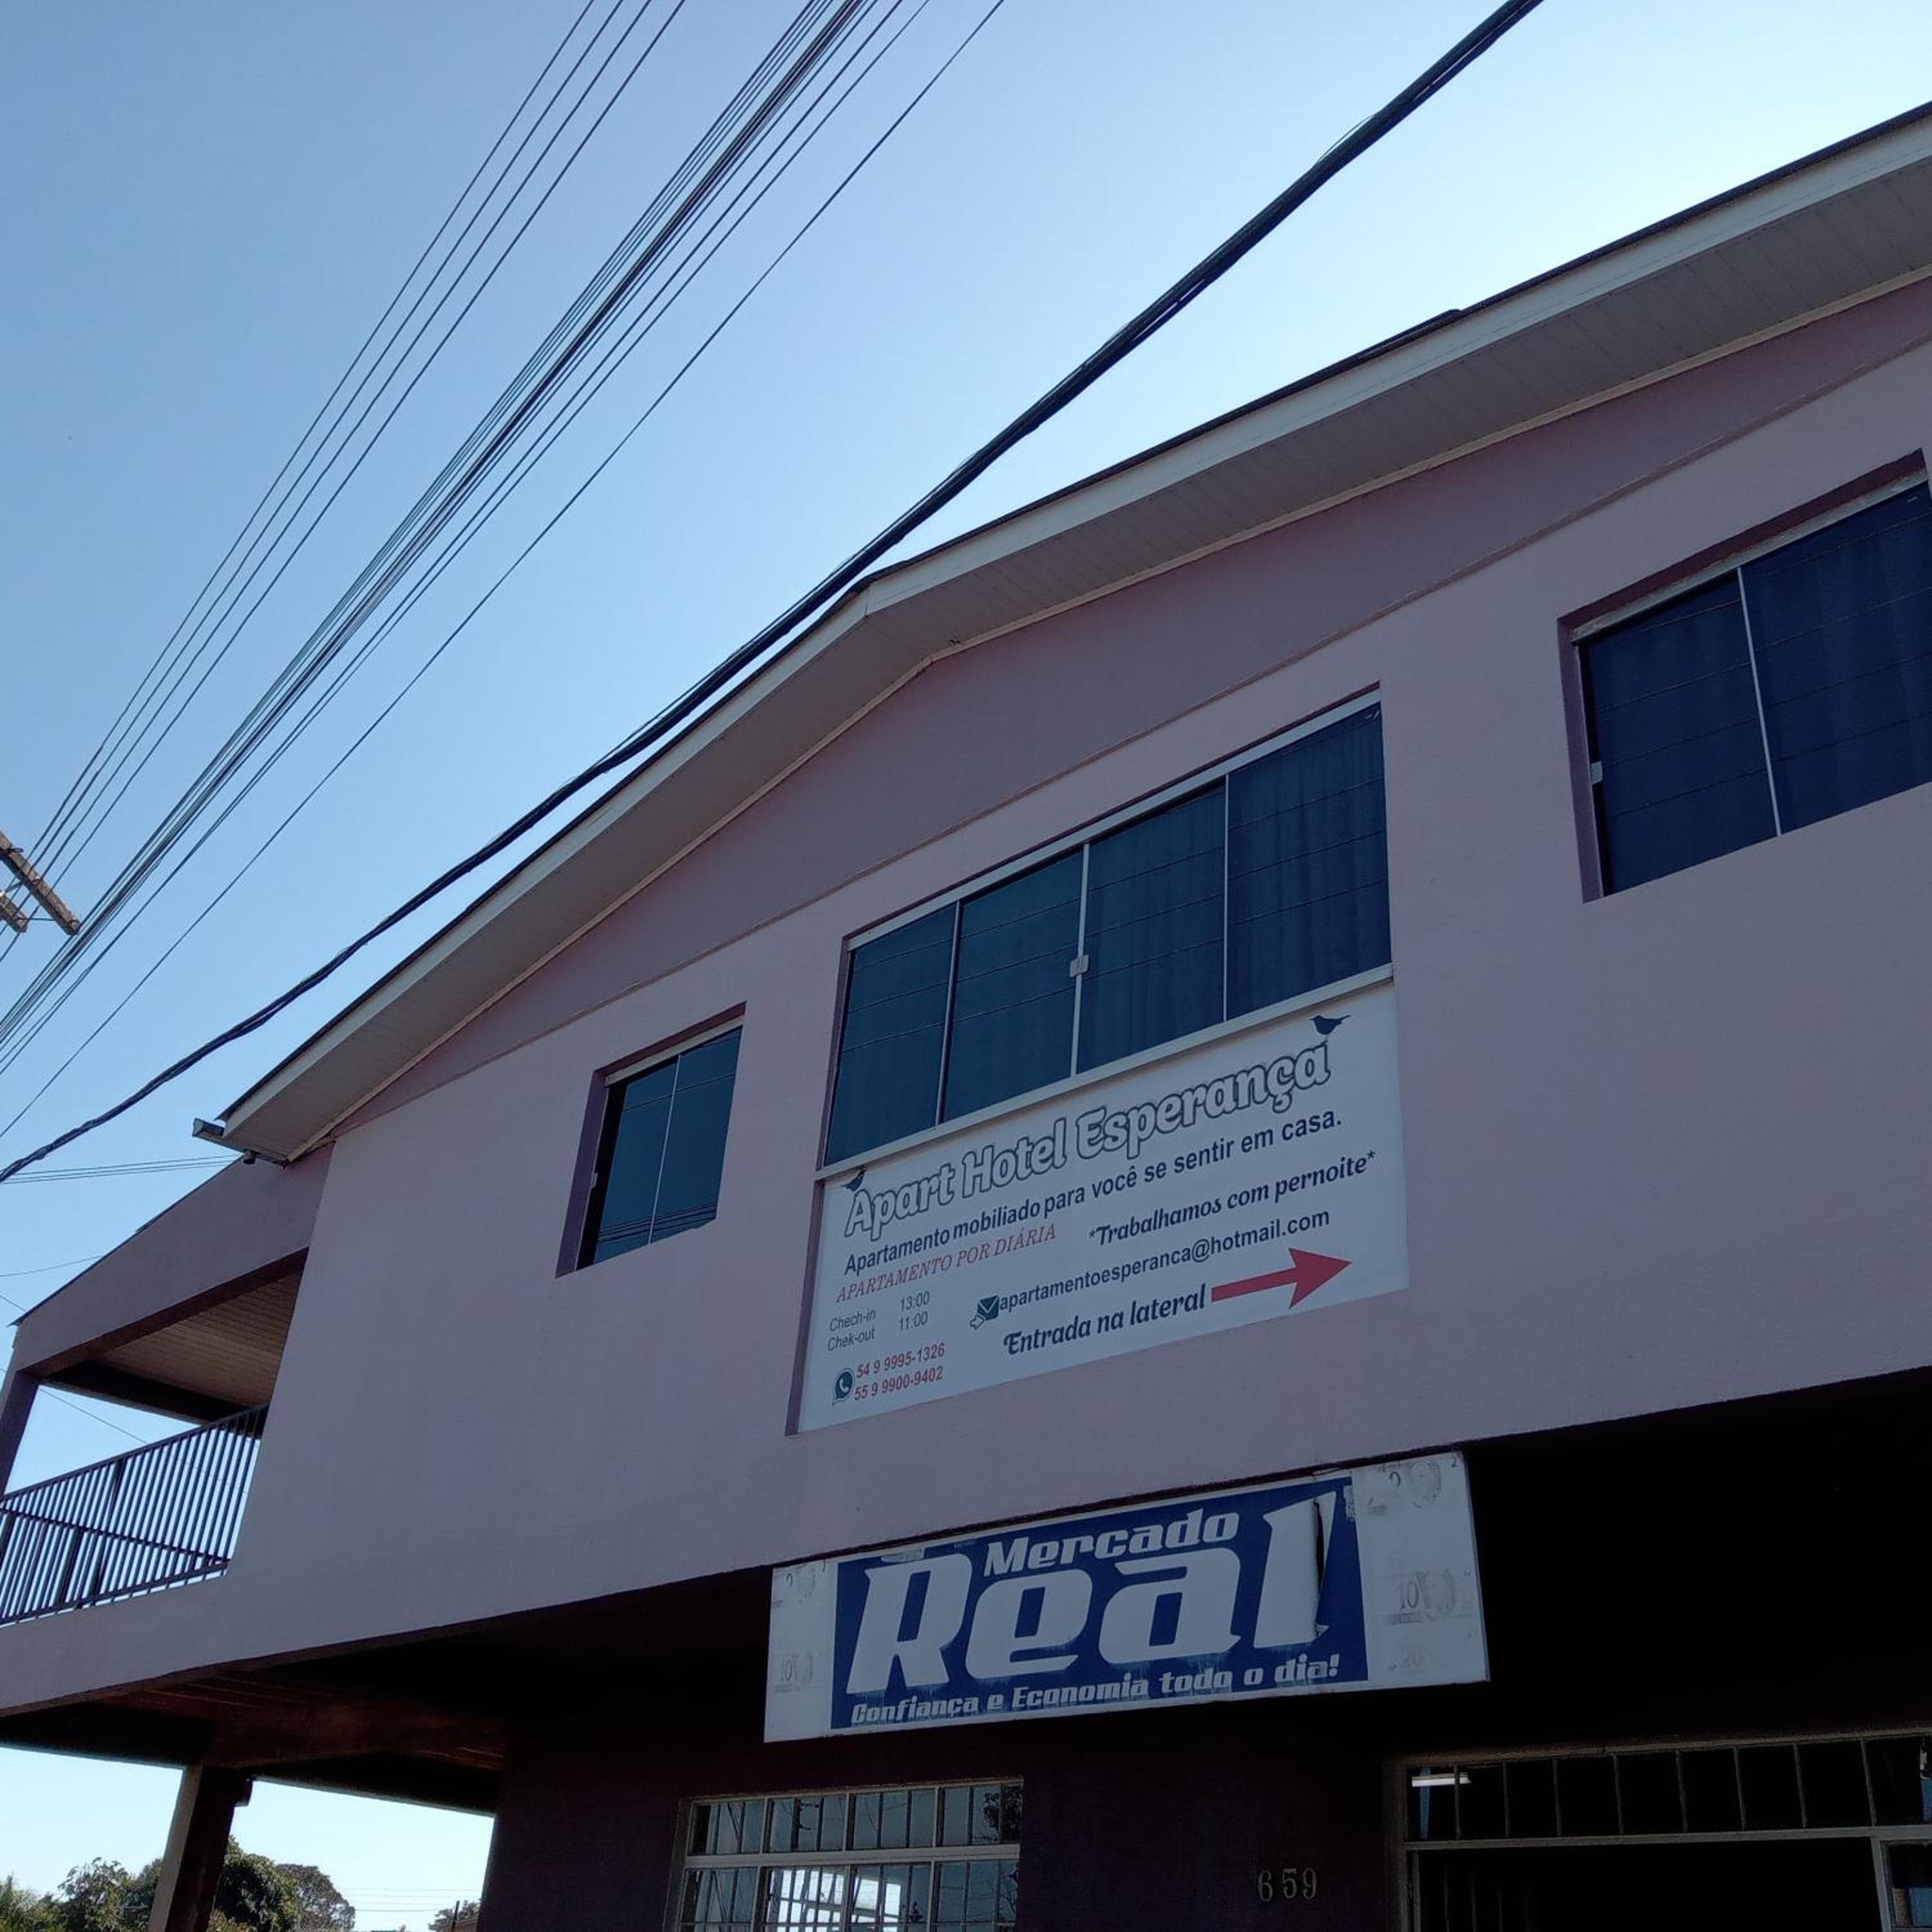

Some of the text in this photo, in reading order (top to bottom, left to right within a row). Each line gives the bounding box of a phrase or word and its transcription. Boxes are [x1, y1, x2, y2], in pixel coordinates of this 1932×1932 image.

[844, 1041, 1331, 1241] Apart Hotel Esperança
[844, 1111, 1341, 1276] Apartamento mobiliado para você se sentir em casa.
[1227, 1184, 1269, 1209] com
[836, 1224, 1057, 1303] APARTAMENTO POR DIÁRIA
[999, 1211, 1329, 1312] apartamentoesperanca@hotmail.com
[898, 1311, 928, 1331] 11:00
[900, 1291, 930, 1311] 13:00
[1003, 1283, 1206, 1355] Entrada na lateral
[828, 1327, 875, 1351] Chek-out
[857, 1342, 945, 1378] 54 9 9995-1326
[854, 1365, 943, 1401] 55 9 9900-9402
[983, 1508, 1240, 1577] Mercado
[846, 1490, 1336, 1694] Real
[851, 1653, 1340, 1724] Confiança e Economia todo o dia!
[1258, 1867, 1317, 1902] 659
